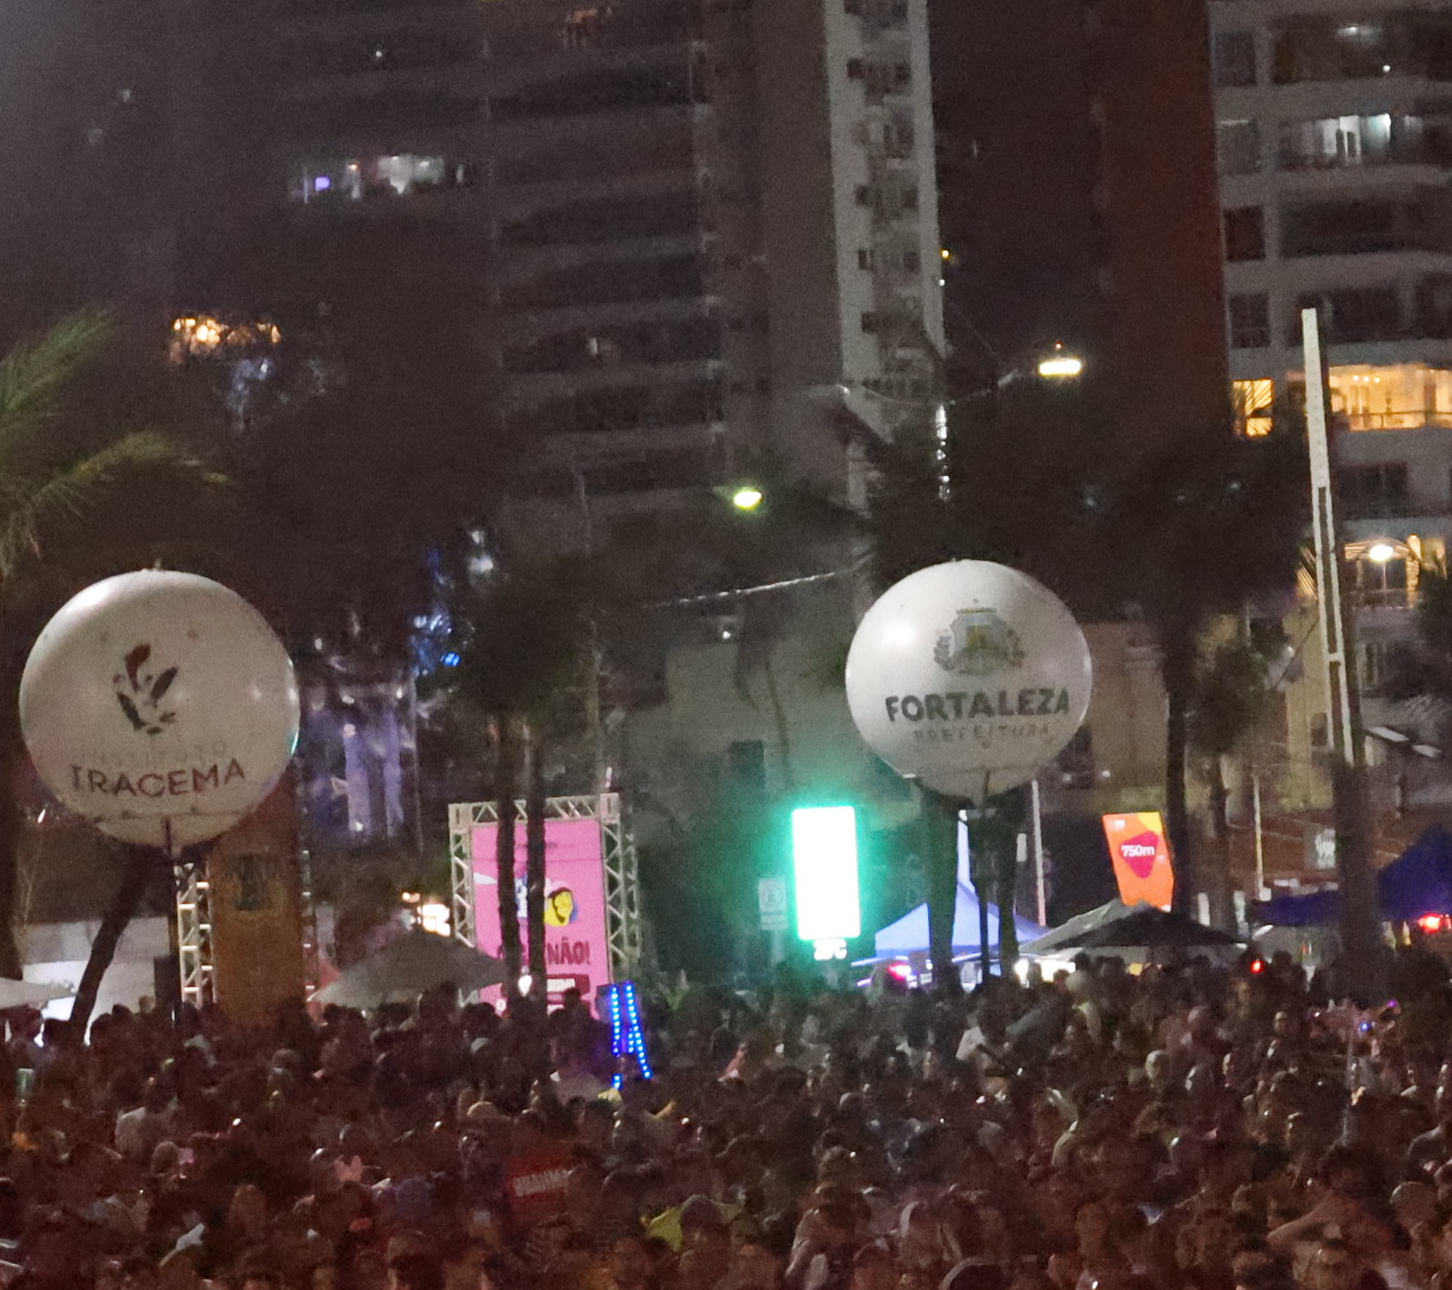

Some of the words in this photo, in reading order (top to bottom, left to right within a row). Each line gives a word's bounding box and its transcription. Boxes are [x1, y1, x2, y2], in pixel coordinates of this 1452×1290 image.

[885, 687, 1070, 722] FORTALEZA
[913, 723, 1050, 743] PREFEITURA
[69, 757, 246, 798] IRACEMA
[1121, 844, 1156, 858] 750m
